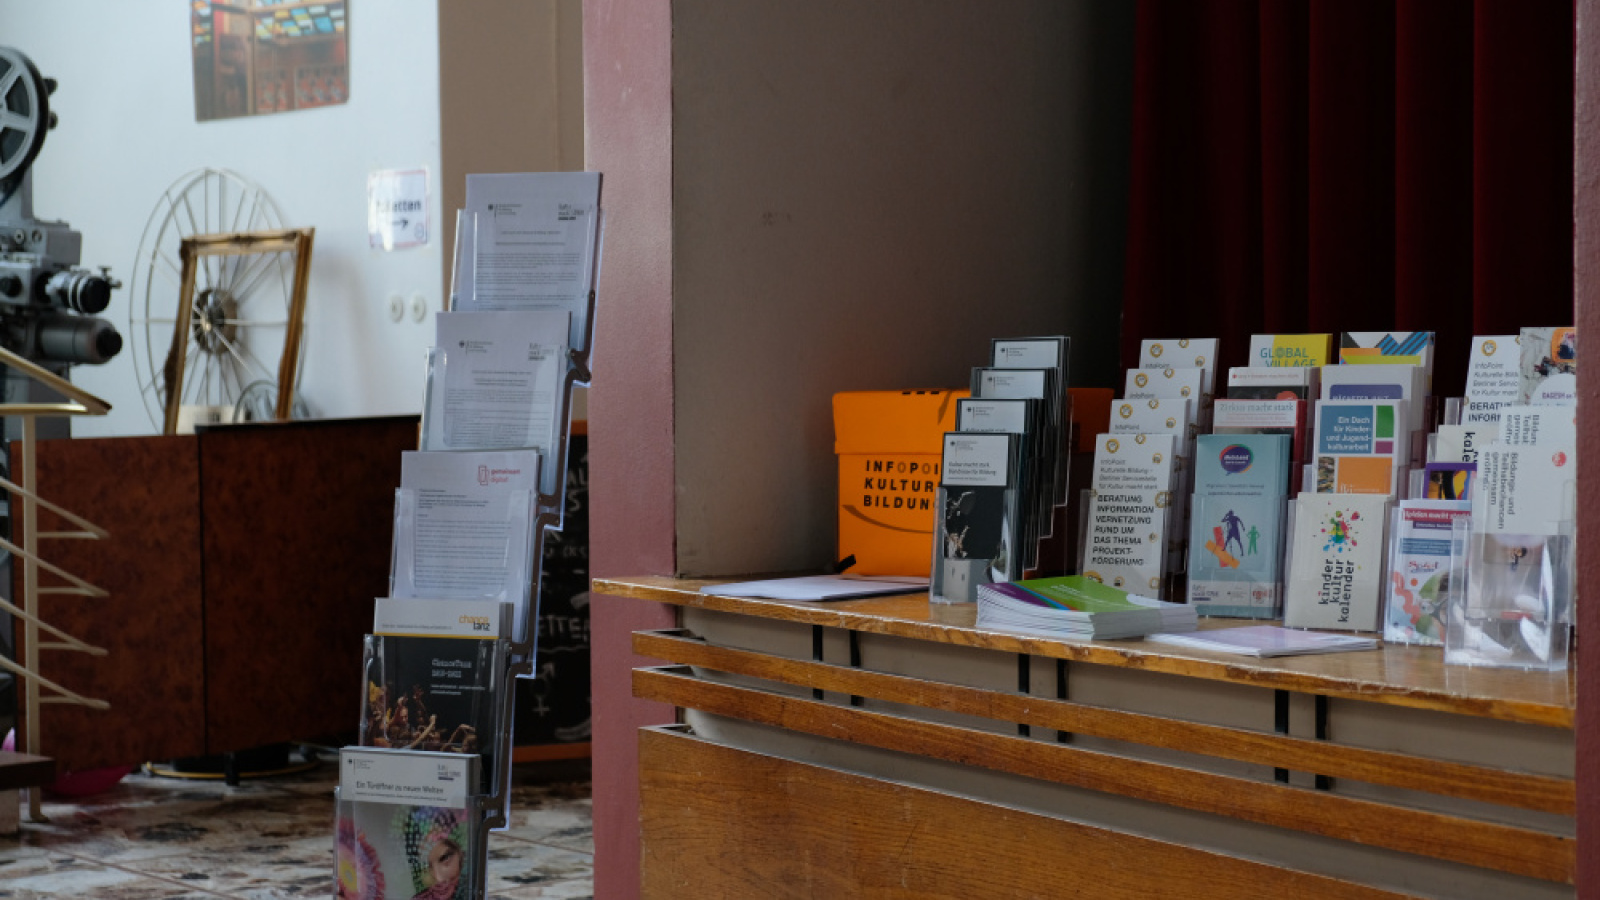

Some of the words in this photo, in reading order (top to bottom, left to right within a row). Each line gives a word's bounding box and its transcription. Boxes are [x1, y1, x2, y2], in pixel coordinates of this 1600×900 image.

[1260, 347, 1309, 358] GLOBAL
[864, 477, 940, 492] KULTUR
[864, 495, 935, 510] BILDUN
[1098, 494, 1142, 503] BERATUNG
[1097, 505, 1154, 514] INFORMATION
[1096, 515, 1152, 524] VERNETZUNG
[1121, 526, 1134, 534] UM
[1094, 536, 1111, 544] DAS
[1113, 536, 1142, 545] THEMA
[1092, 546, 1133, 554] PROJEKT-
[1091, 556, 1144, 566] FÖRDERUNG
[1318, 559, 1334, 605] kinder
[1329, 559, 1344, 604] kultur
[1337, 560, 1354, 623] kalender
